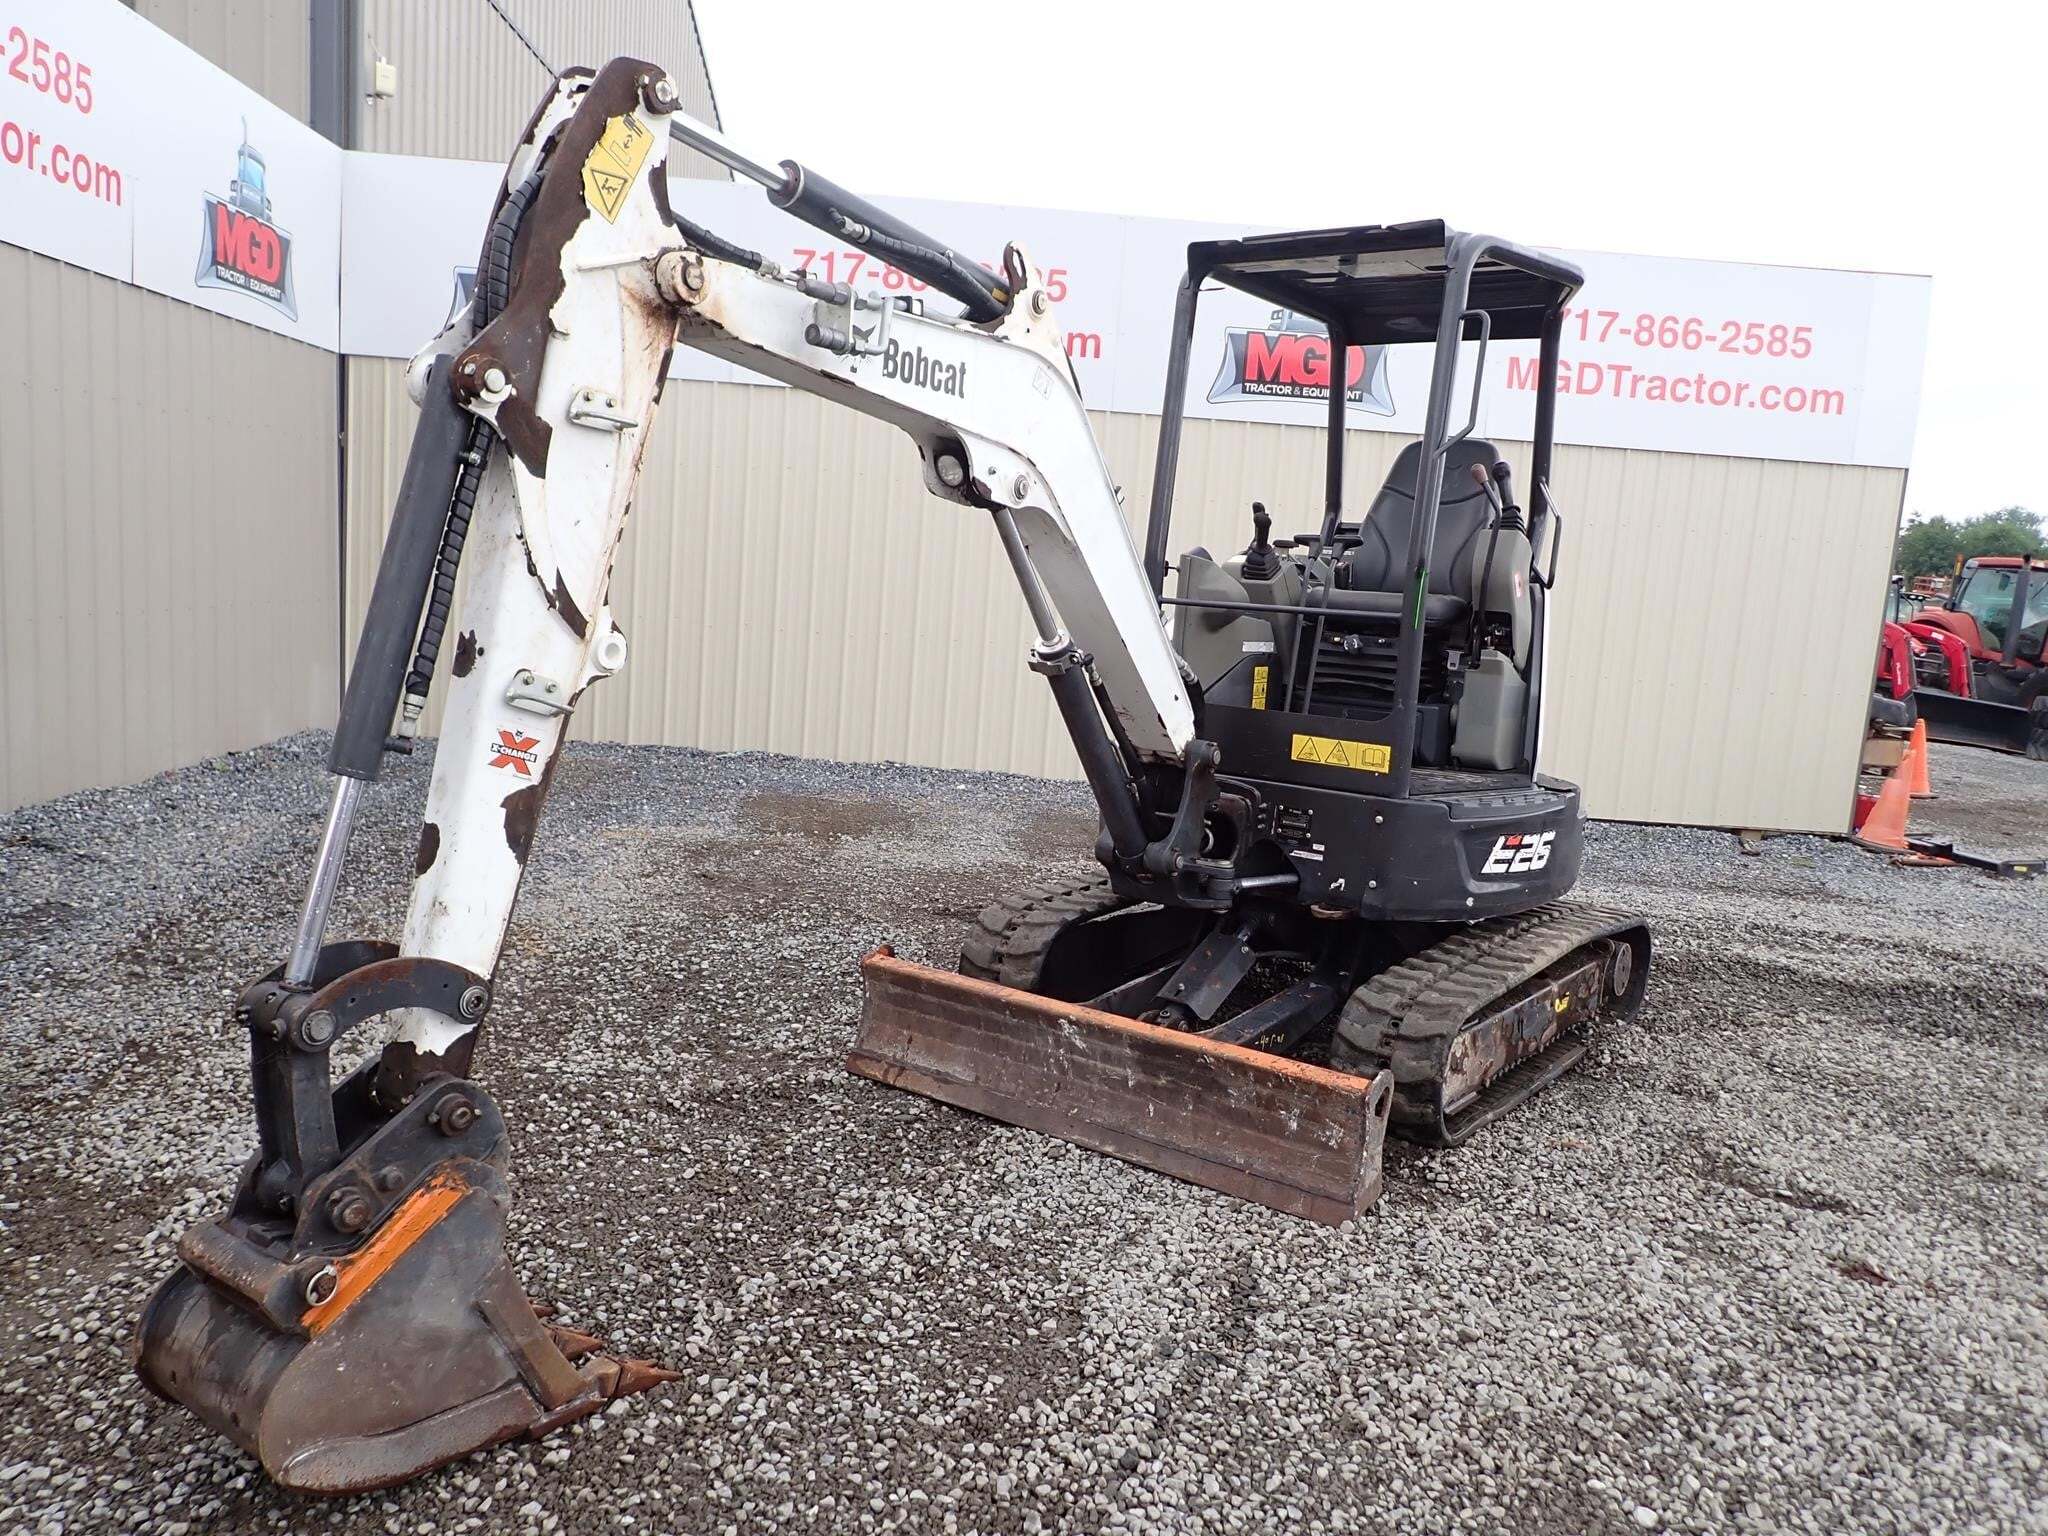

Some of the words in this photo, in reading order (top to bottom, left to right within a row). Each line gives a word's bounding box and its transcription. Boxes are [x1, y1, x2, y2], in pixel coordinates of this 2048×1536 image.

[216, 202, 283, 285] MGD
[216, 265, 246, 285] TRACTOR
[882, 338, 966, 399] Bobcat
[1244, 382, 1292, 395] TRACTOR
[1293, 386, 1301, 395] &
[1302, 386, 1362, 400] EQUINT
[1481, 830, 1556, 873] E26
